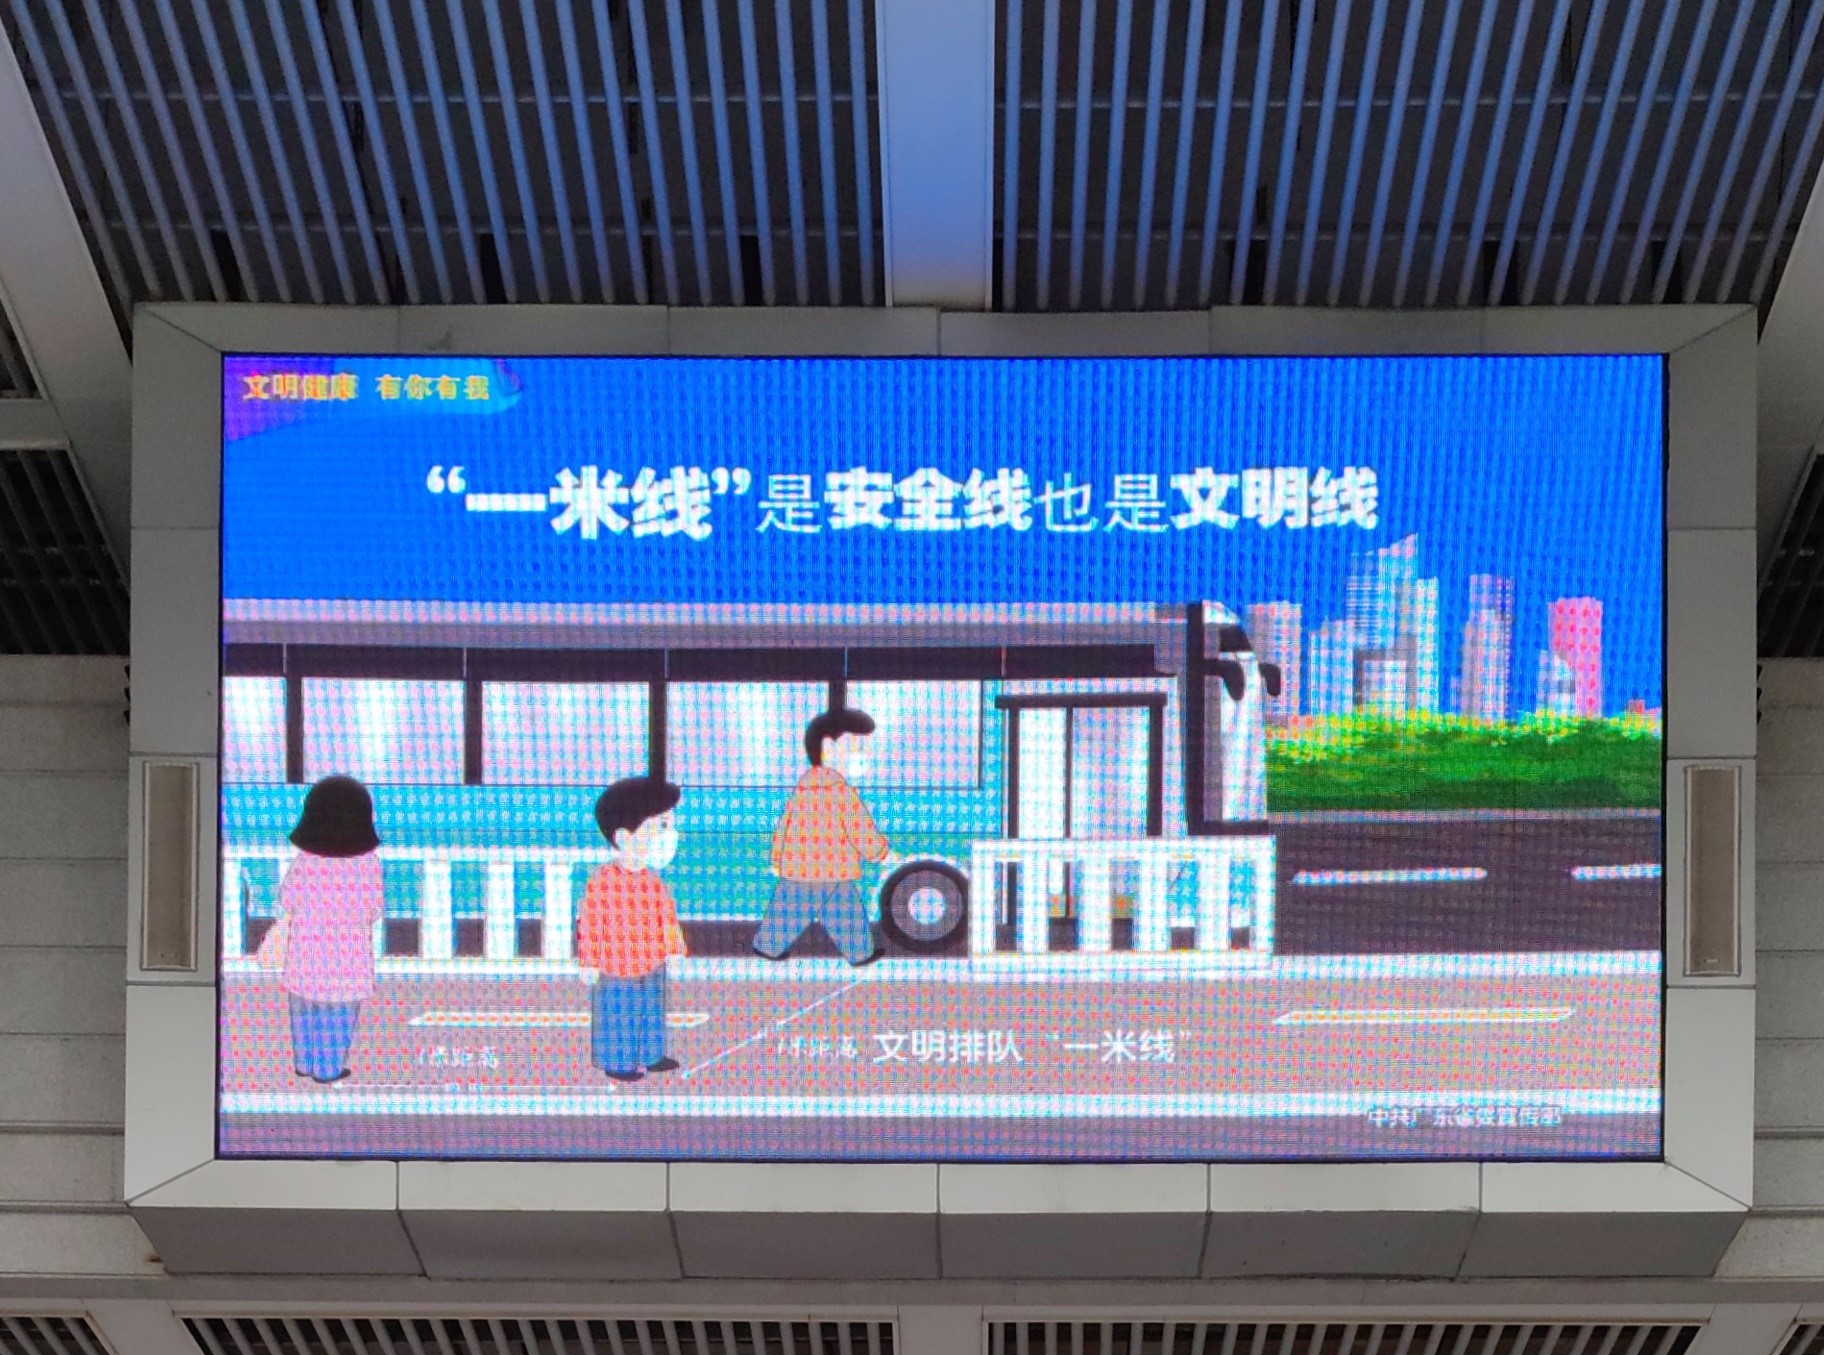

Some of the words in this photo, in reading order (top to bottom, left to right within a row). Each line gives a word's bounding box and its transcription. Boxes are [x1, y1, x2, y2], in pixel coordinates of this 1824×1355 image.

[424, 464, 1381, 541] “一米线”是安全线也是文明线
[873, 1028, 1025, 1063] 文明排队
